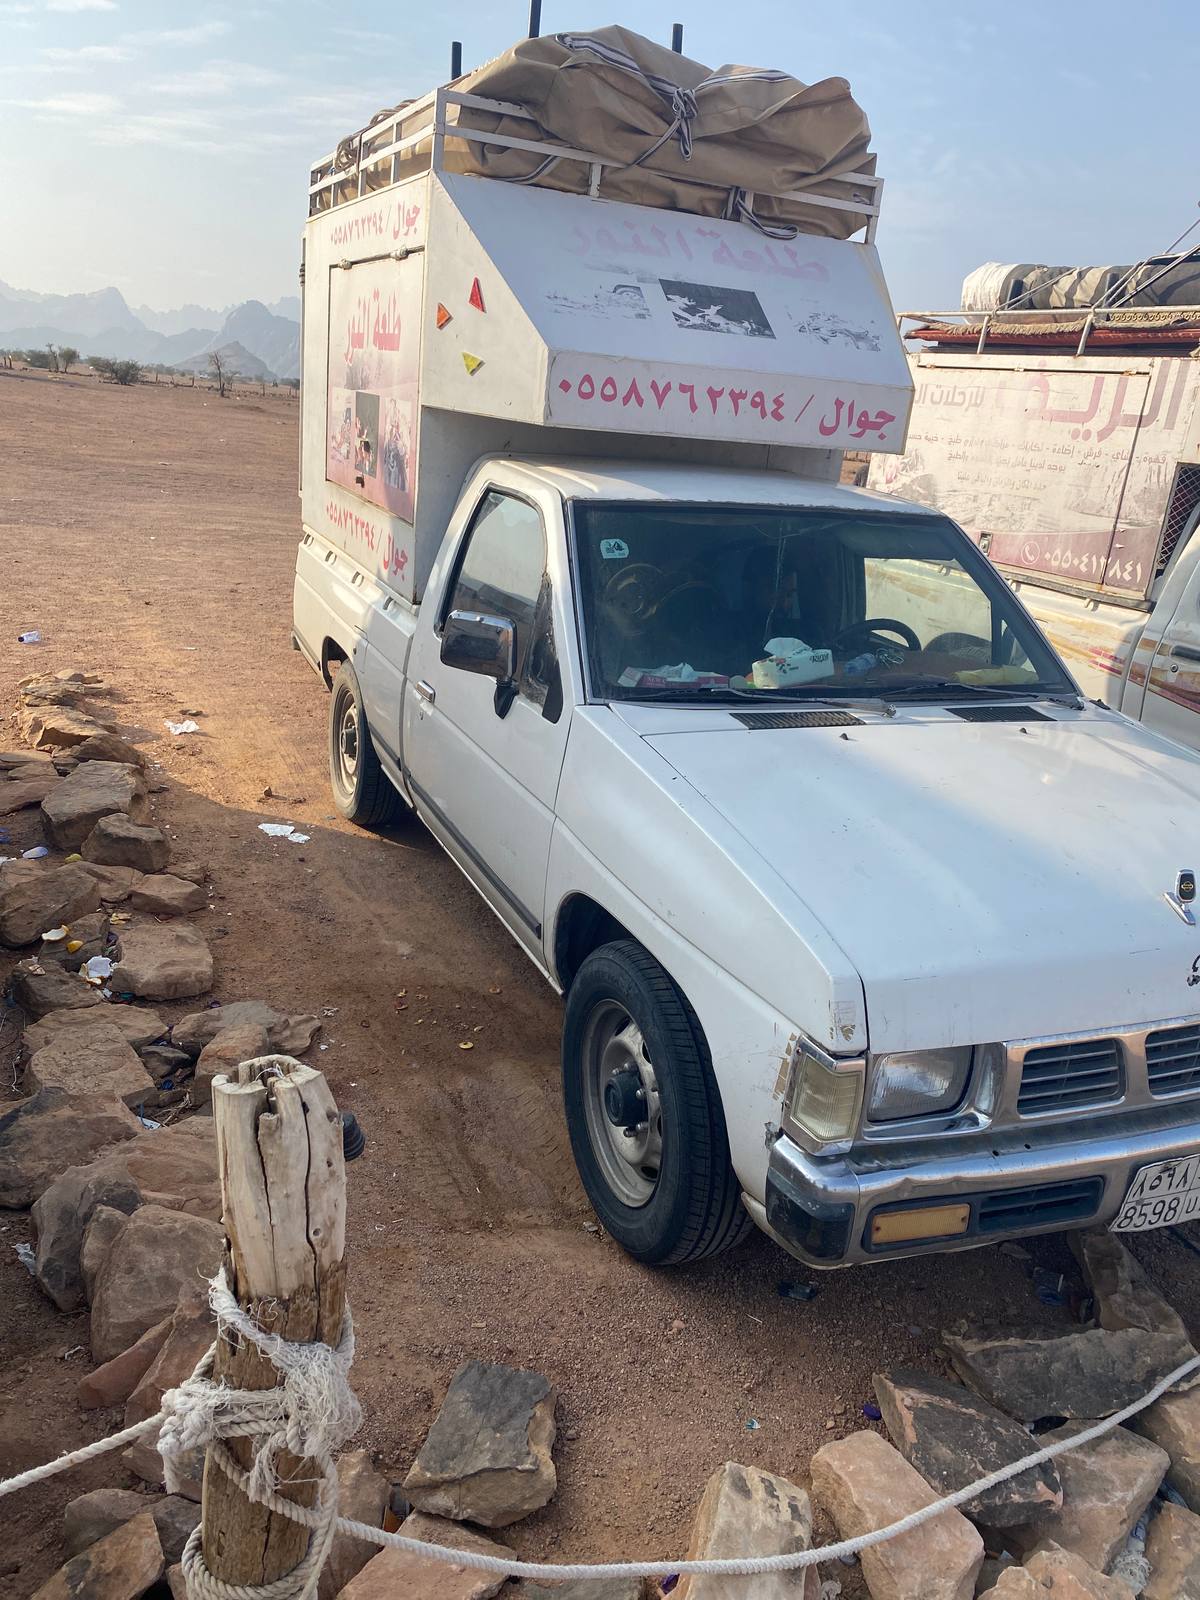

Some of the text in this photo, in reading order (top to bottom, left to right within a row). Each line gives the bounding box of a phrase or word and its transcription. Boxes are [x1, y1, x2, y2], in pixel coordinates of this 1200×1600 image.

[392, 201, 421, 240] جوال
[372, 287, 401, 351] طلعة
[558, 373, 786, 422] ٠٥٥٨٧٦٢٣٩٤
[818, 397, 896, 439] جوال
[931, 383, 985, 412] للرحلات
[383, 532, 408, 581] جوال
[1117, 1197, 1181, 1229] 8598
